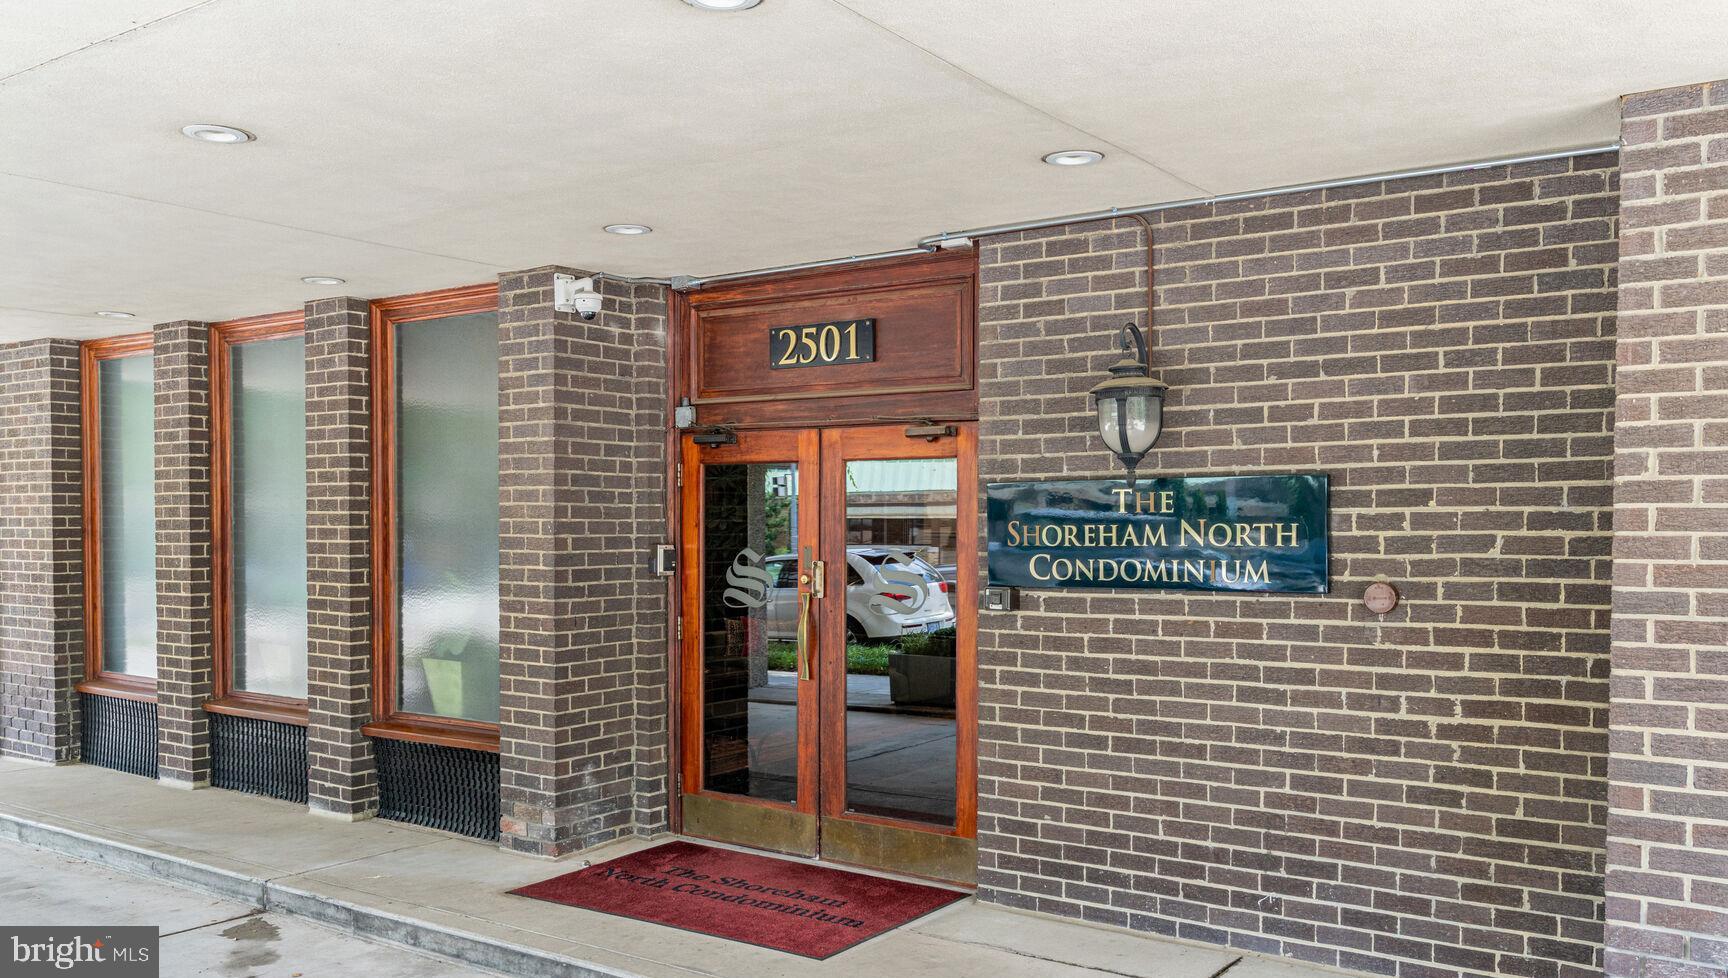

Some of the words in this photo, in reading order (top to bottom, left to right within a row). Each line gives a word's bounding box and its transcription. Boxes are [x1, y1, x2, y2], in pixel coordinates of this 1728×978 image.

[779, 322, 861, 365] 2501
[1112, 488, 1175, 514] THE
[1007, 520, 1169, 547] SHOREHAM
[1178, 518, 1300, 548] NORTH
[1028, 553, 1272, 584] CONDOMINIUM
[604, 865, 669, 889] North
[672, 882, 866, 929] Condominium
[661, 865, 710, 882] The
[711, 875, 849, 909] Shoreham
